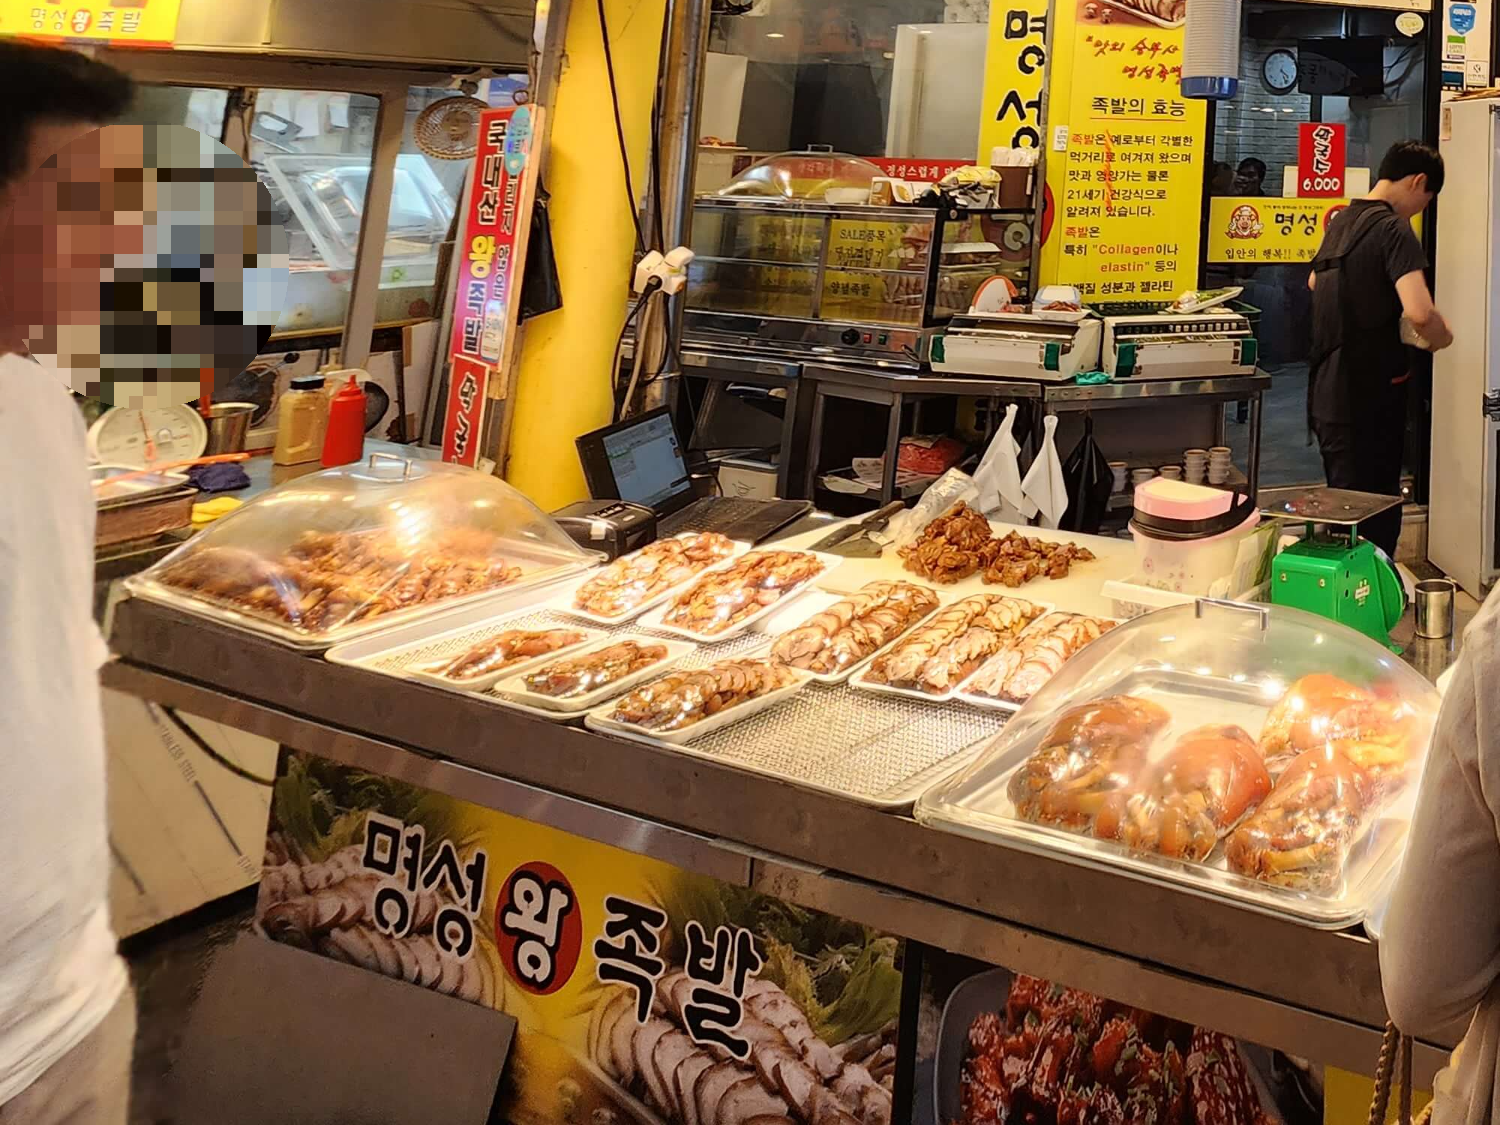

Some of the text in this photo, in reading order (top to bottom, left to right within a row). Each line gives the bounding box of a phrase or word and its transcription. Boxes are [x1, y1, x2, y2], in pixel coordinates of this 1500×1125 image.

[1091, 97, 1186, 117] 족발의 효능
[1071, 134, 1106, 146] 족발은
[1111, 134, 1156, 146] 예로부터
[1160, 135, 1193, 147] 각별한
[1070, 151, 1192, 164] 먹거리로 여겨져 왔으며
[1068, 170, 1169, 182] 맛과 영양가는 물론
[1302, 178, 1340, 191] 6.000
[1067, 188, 1167, 201] 21세기 건강식으로
[1066, 205, 1156, 217] 알려져 있습니다.
[1275, 213, 1317, 236] 명성
[1065, 226, 1100, 238] 족발은
[1064, 244, 1178, 256] 특히 "Collagen이나
[1225, 248, 1257, 260] 입안의
[469, 234, 496, 280] 왕
[1100, 260, 1177, 273] elastin" 등의
[1100, 281, 1136, 294] 성분과
[1139, 280, 1173, 293] 젤라틴
[362, 810, 767, 1062] 명성 왕 족발
